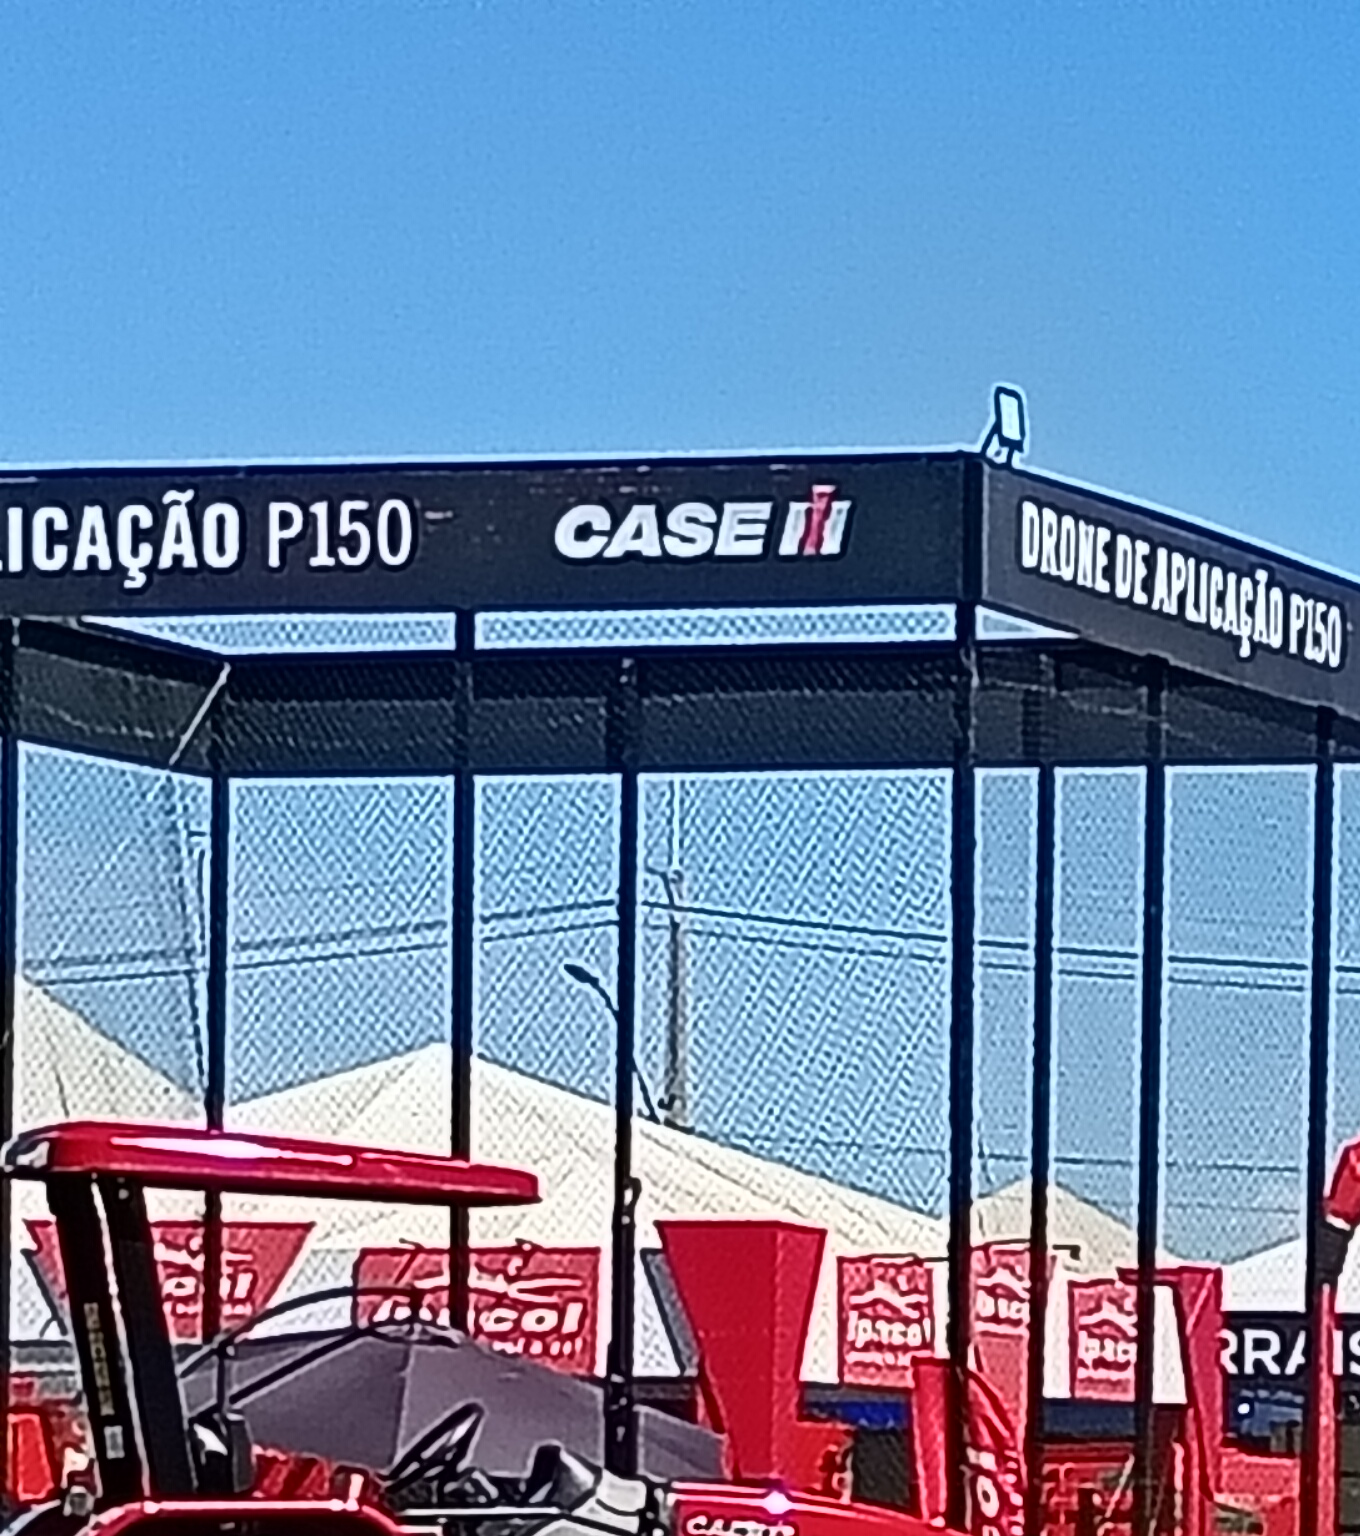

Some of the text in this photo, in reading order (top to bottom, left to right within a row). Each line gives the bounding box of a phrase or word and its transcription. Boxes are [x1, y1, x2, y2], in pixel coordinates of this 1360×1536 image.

[0, 489, 413, 588] ICAÇÃO P150
[554, 502, 773, 559] CASE
[1021, 501, 1342, 668] DRONE DE APLICAÇÃO P150
